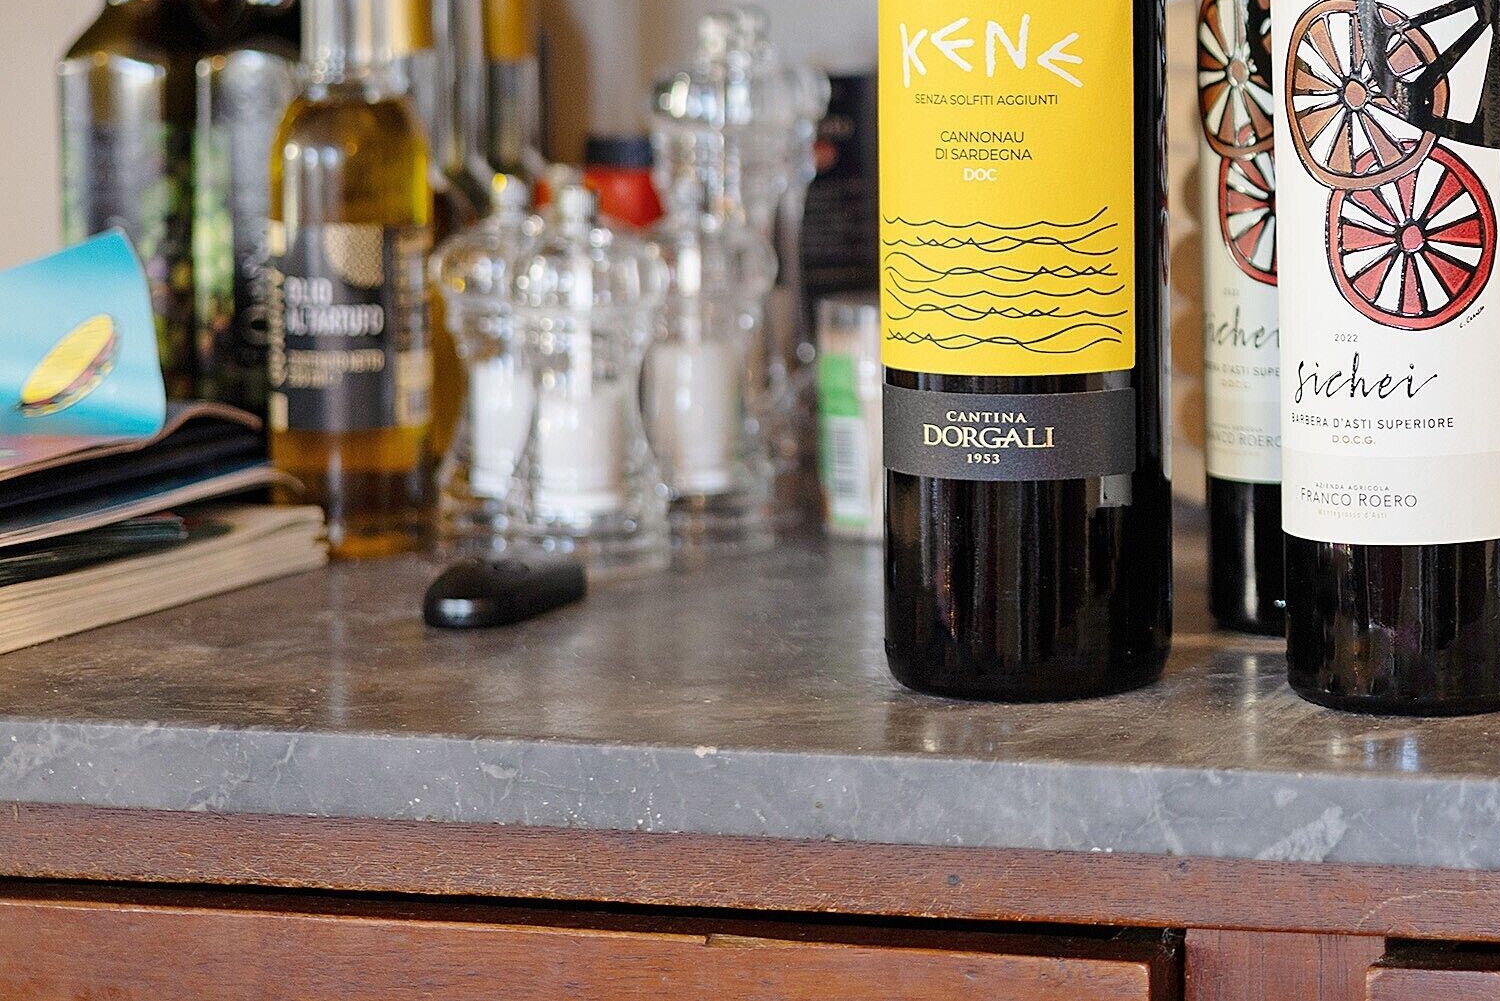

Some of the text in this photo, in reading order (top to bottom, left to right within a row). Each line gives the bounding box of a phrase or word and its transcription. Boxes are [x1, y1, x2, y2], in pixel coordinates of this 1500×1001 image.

[899, 13, 1084, 88] KENE
[915, 94, 1058, 106] SENZA SOLFITI AGGIUNTI
[940, 131, 1024, 143] CANNONAU
[935, 148, 1032, 161] DI SARDEGNA
[963, 168, 997, 181] DOC
[1334, 333, 1359, 343] 2022
[946, 411, 1027, 423] CANTINA
[1291, 412, 1454, 429] BARBERA D'ASTI SUPERIORE
[923, 424, 1055, 449] DORGALI
[1331, 434, 1376, 445] D.O.C.G.
[966, 453, 1000, 464] 1953
[1301, 487, 1417, 507] FRANCO ROERO
